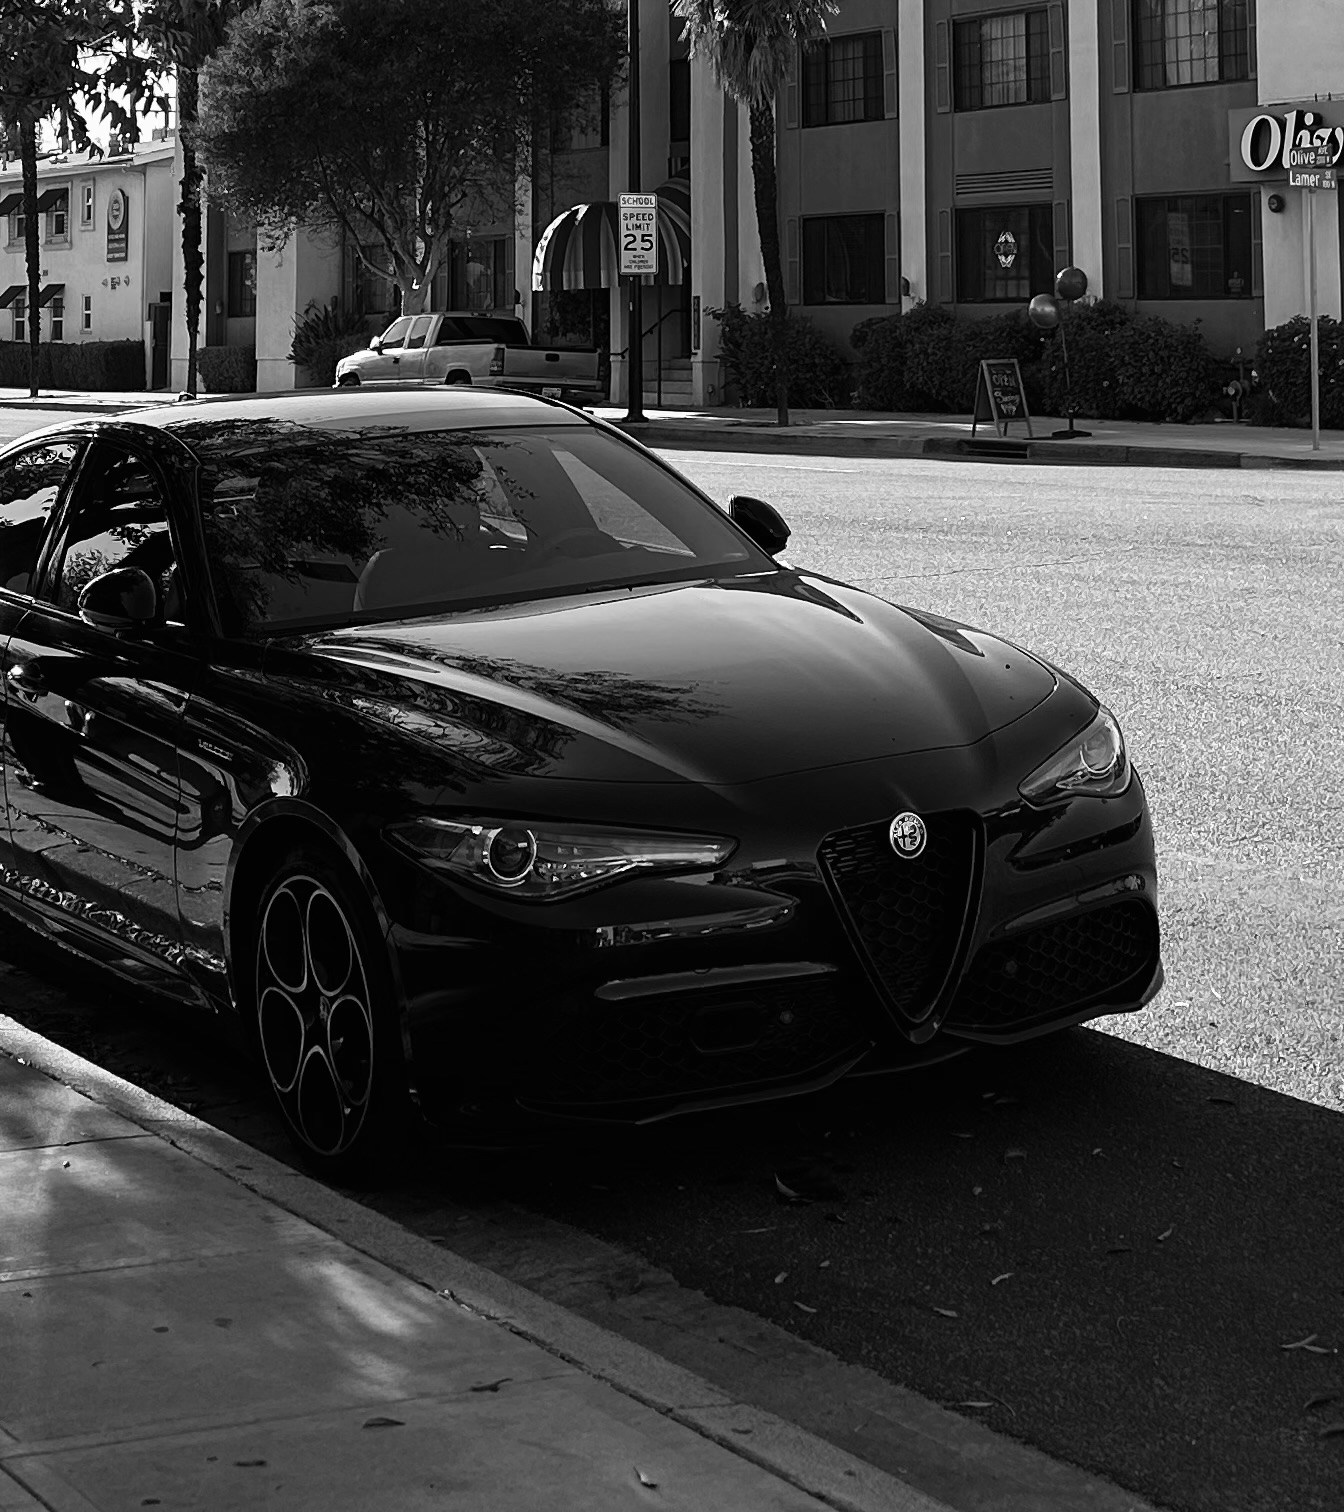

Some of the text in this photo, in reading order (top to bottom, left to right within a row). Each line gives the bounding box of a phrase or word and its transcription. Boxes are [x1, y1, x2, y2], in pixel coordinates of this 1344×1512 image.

[1290, 149, 1316, 165] Olive
[1289, 170, 1320, 186] Lamer
[621, 197, 654, 205] SCHOOL
[622, 213, 654, 221] SPEED
[625, 223, 650, 231] LIMIT
[624, 234, 654, 251] 25
